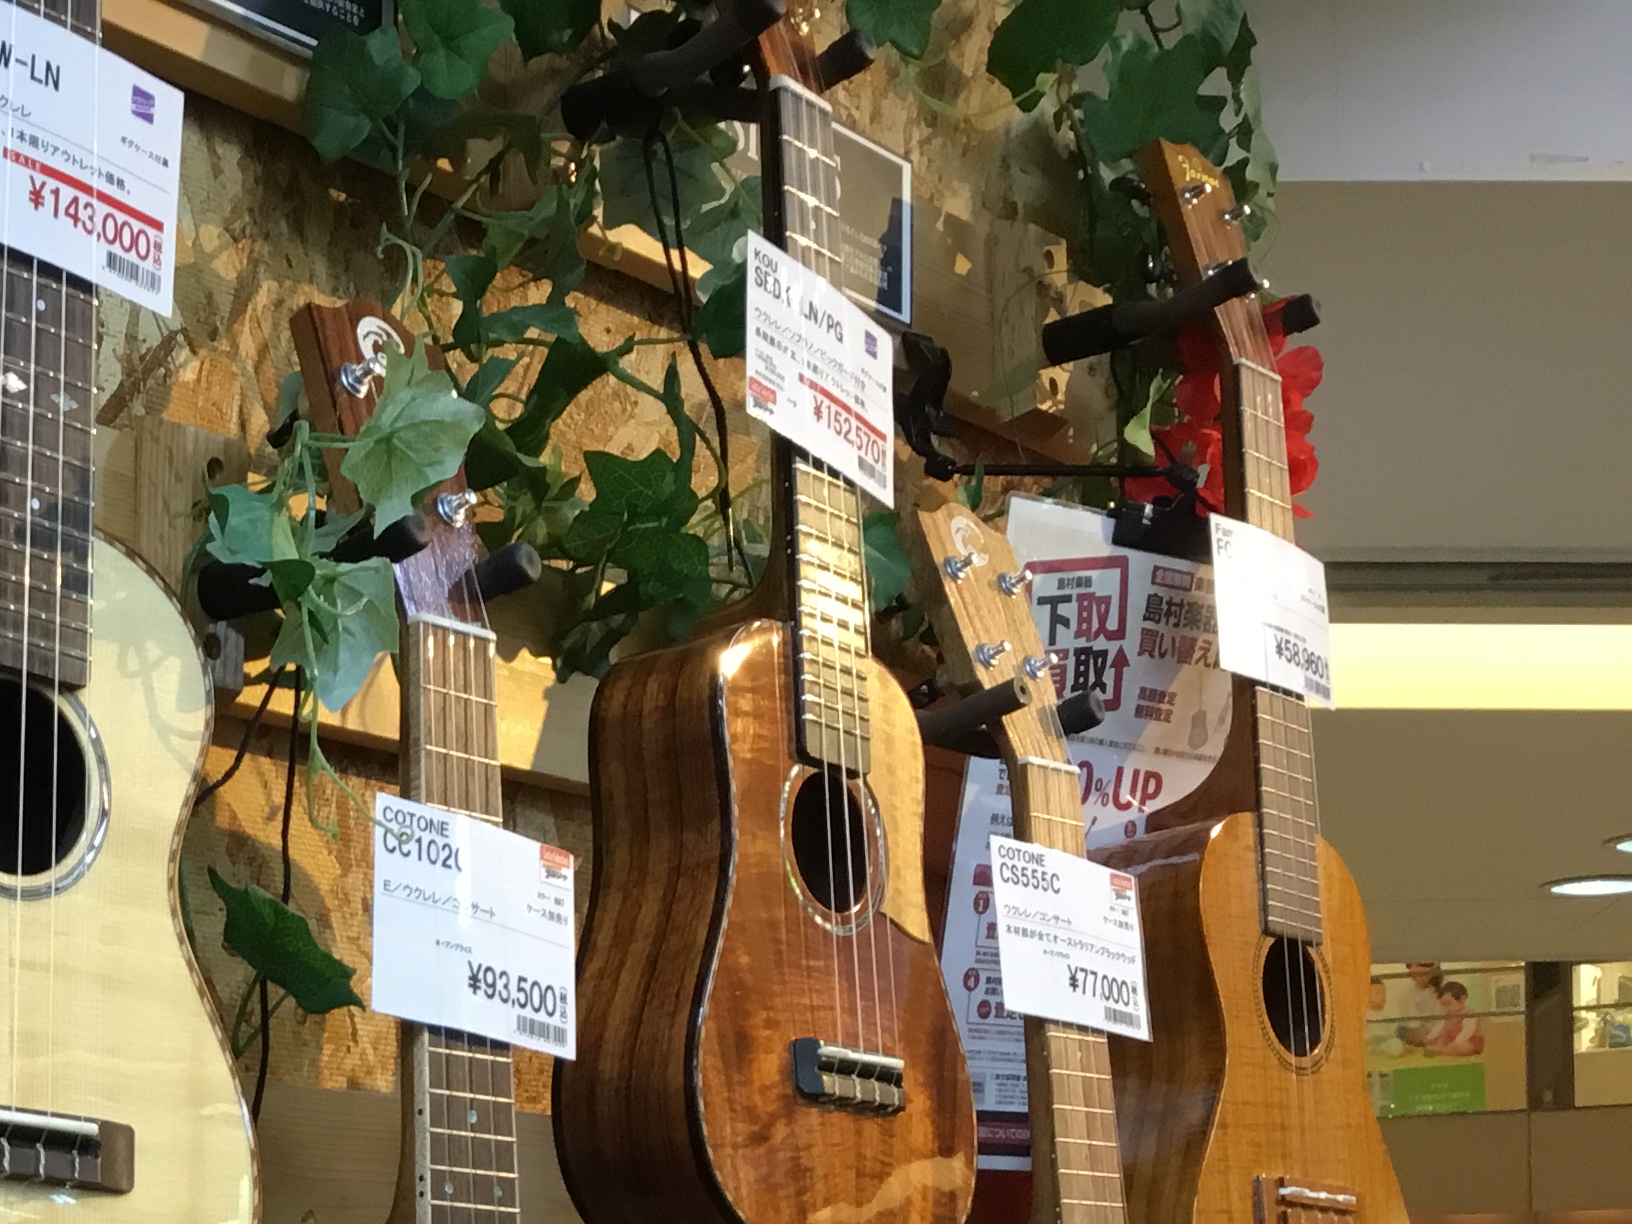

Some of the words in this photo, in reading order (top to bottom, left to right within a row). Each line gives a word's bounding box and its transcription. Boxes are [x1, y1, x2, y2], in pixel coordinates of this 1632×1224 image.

[28, 175, 151, 261] ¥143,000
[754, 247, 778, 274] KOU
[813, 394, 881, 465] ¥152,570
[383, 805, 450, 839] COTONE
[998, 844, 1046, 868] COTONE
[999, 862, 1062, 895] CS555C
[467, 959, 558, 1018] ¥93,500
